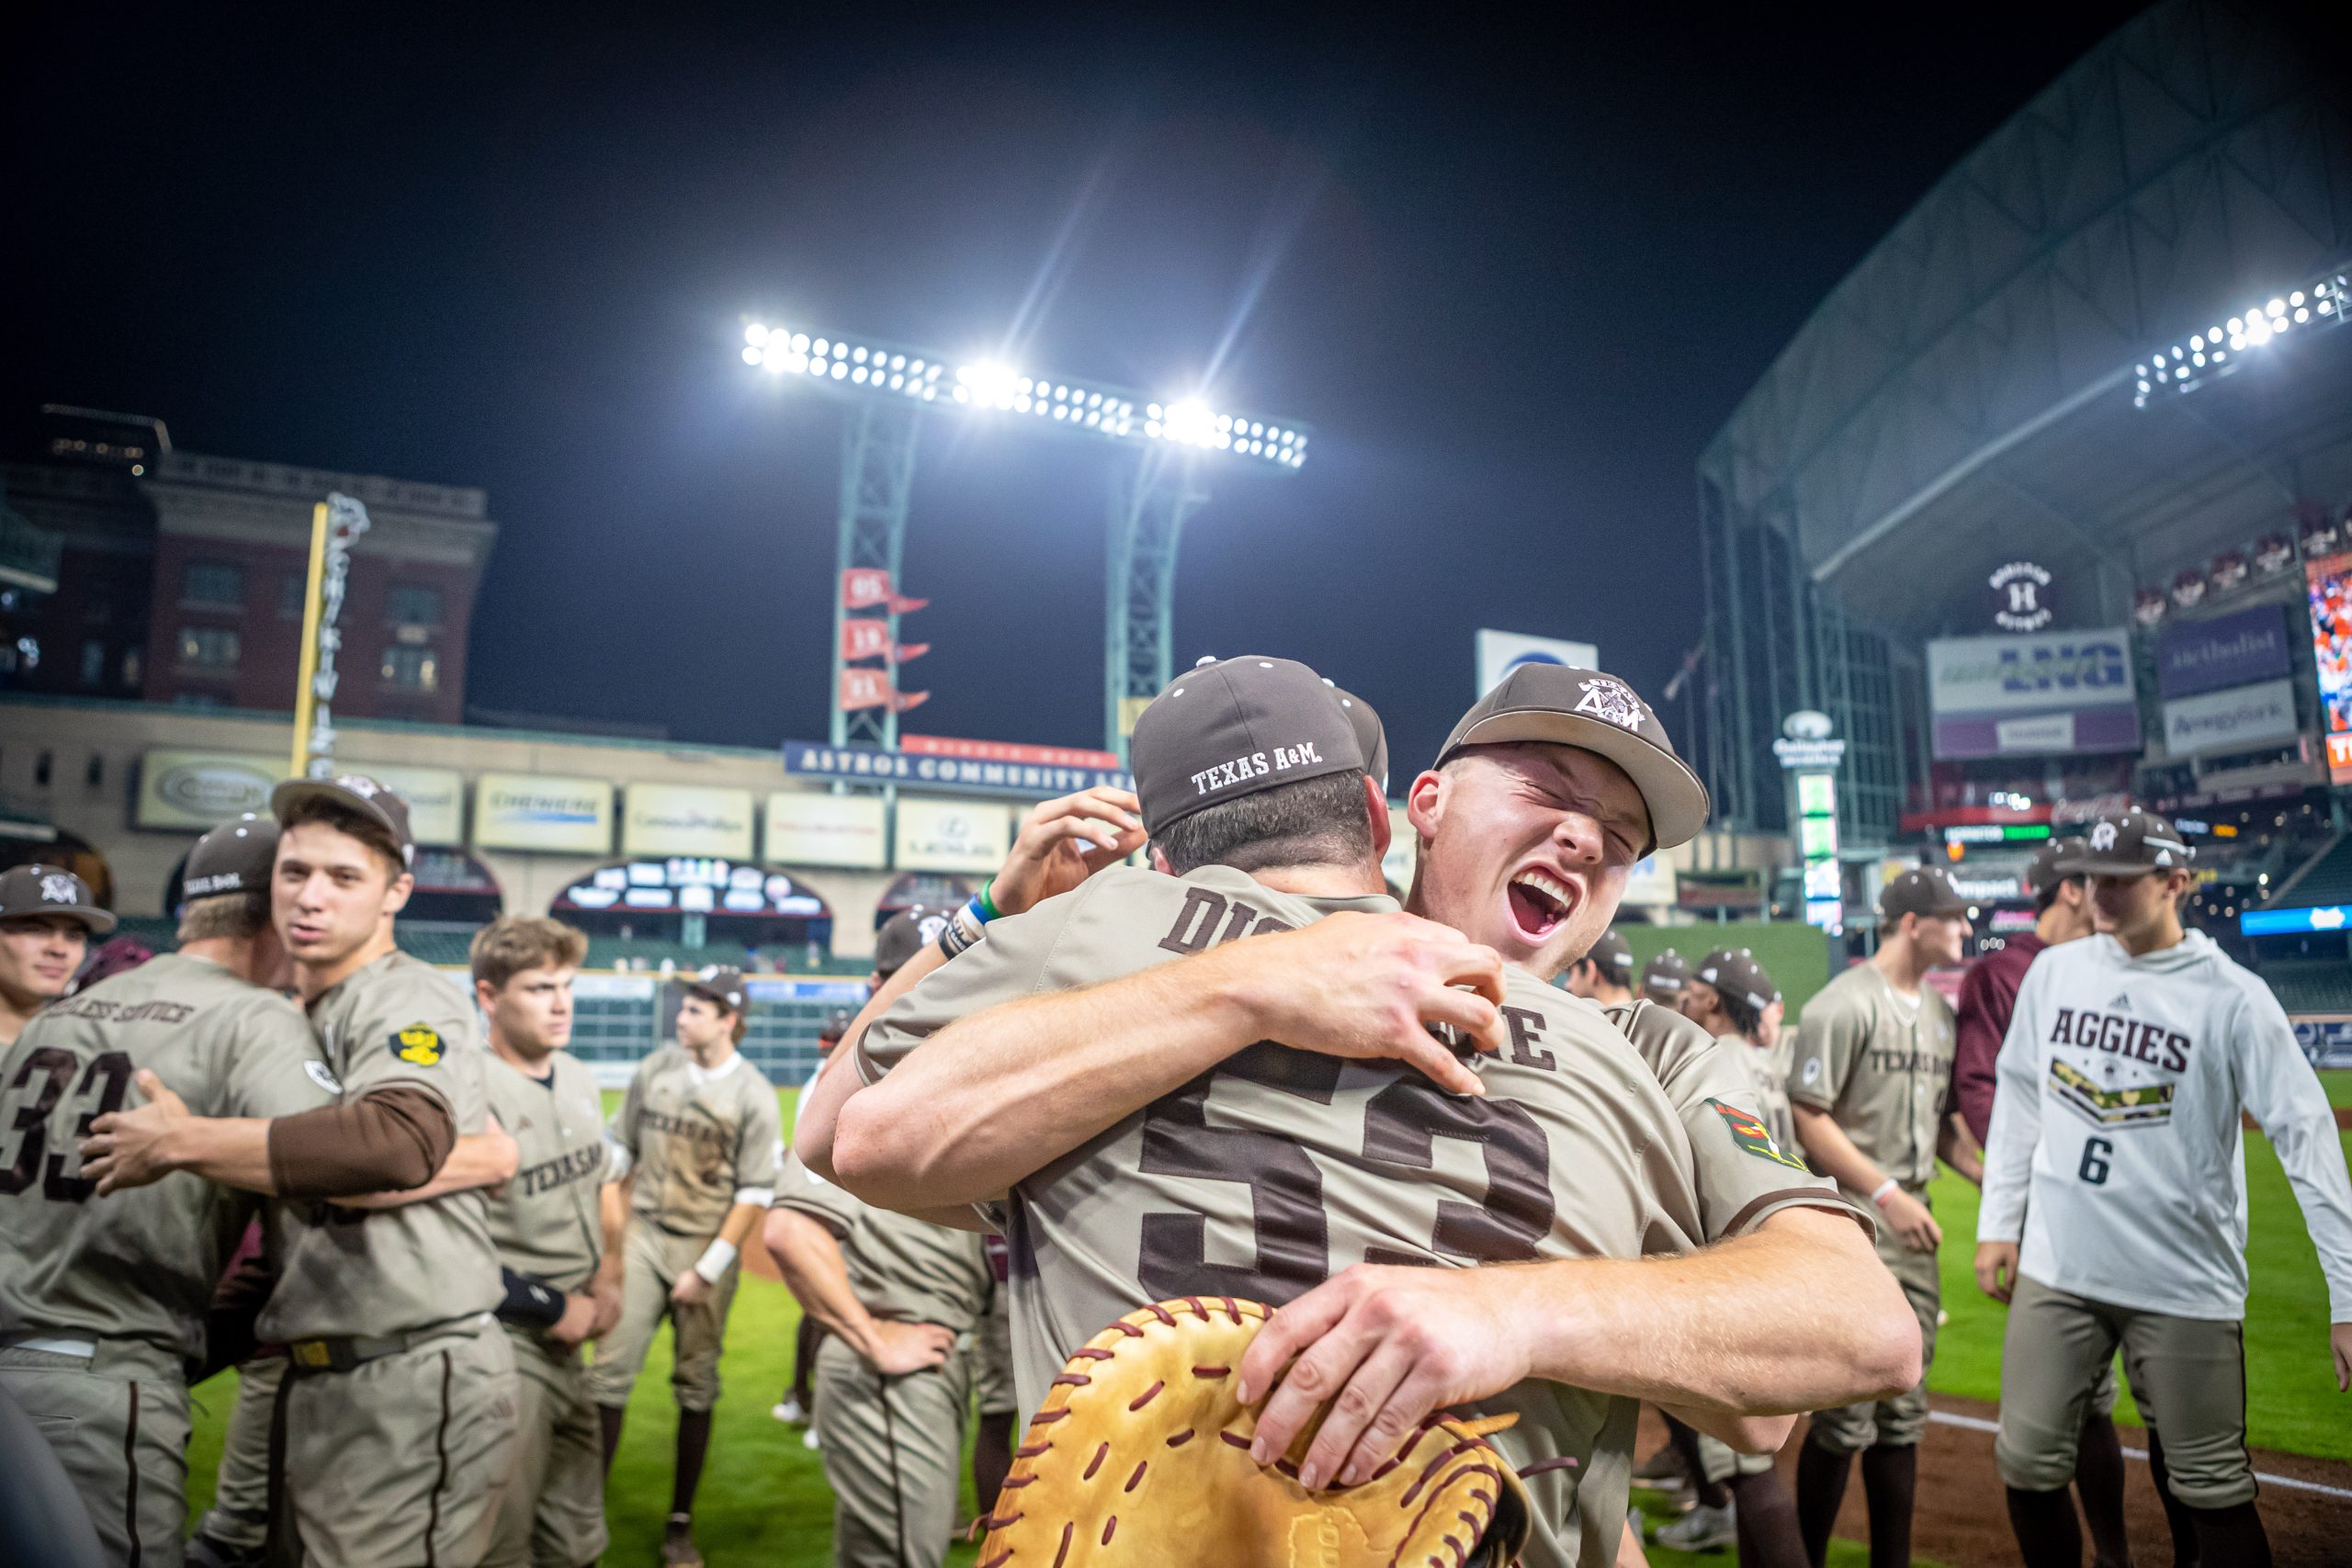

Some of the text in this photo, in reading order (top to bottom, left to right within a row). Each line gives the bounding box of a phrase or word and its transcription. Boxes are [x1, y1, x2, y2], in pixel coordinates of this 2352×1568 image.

[800, 747, 909, 778] ASTROS
[918, 755, 1085, 791] COMMUNITY
[1191, 741, 1323, 795] TEXAS A&M
[2050, 1009, 2191, 1074] AGGIES
[2078, 1134, 2114, 1187] 6
